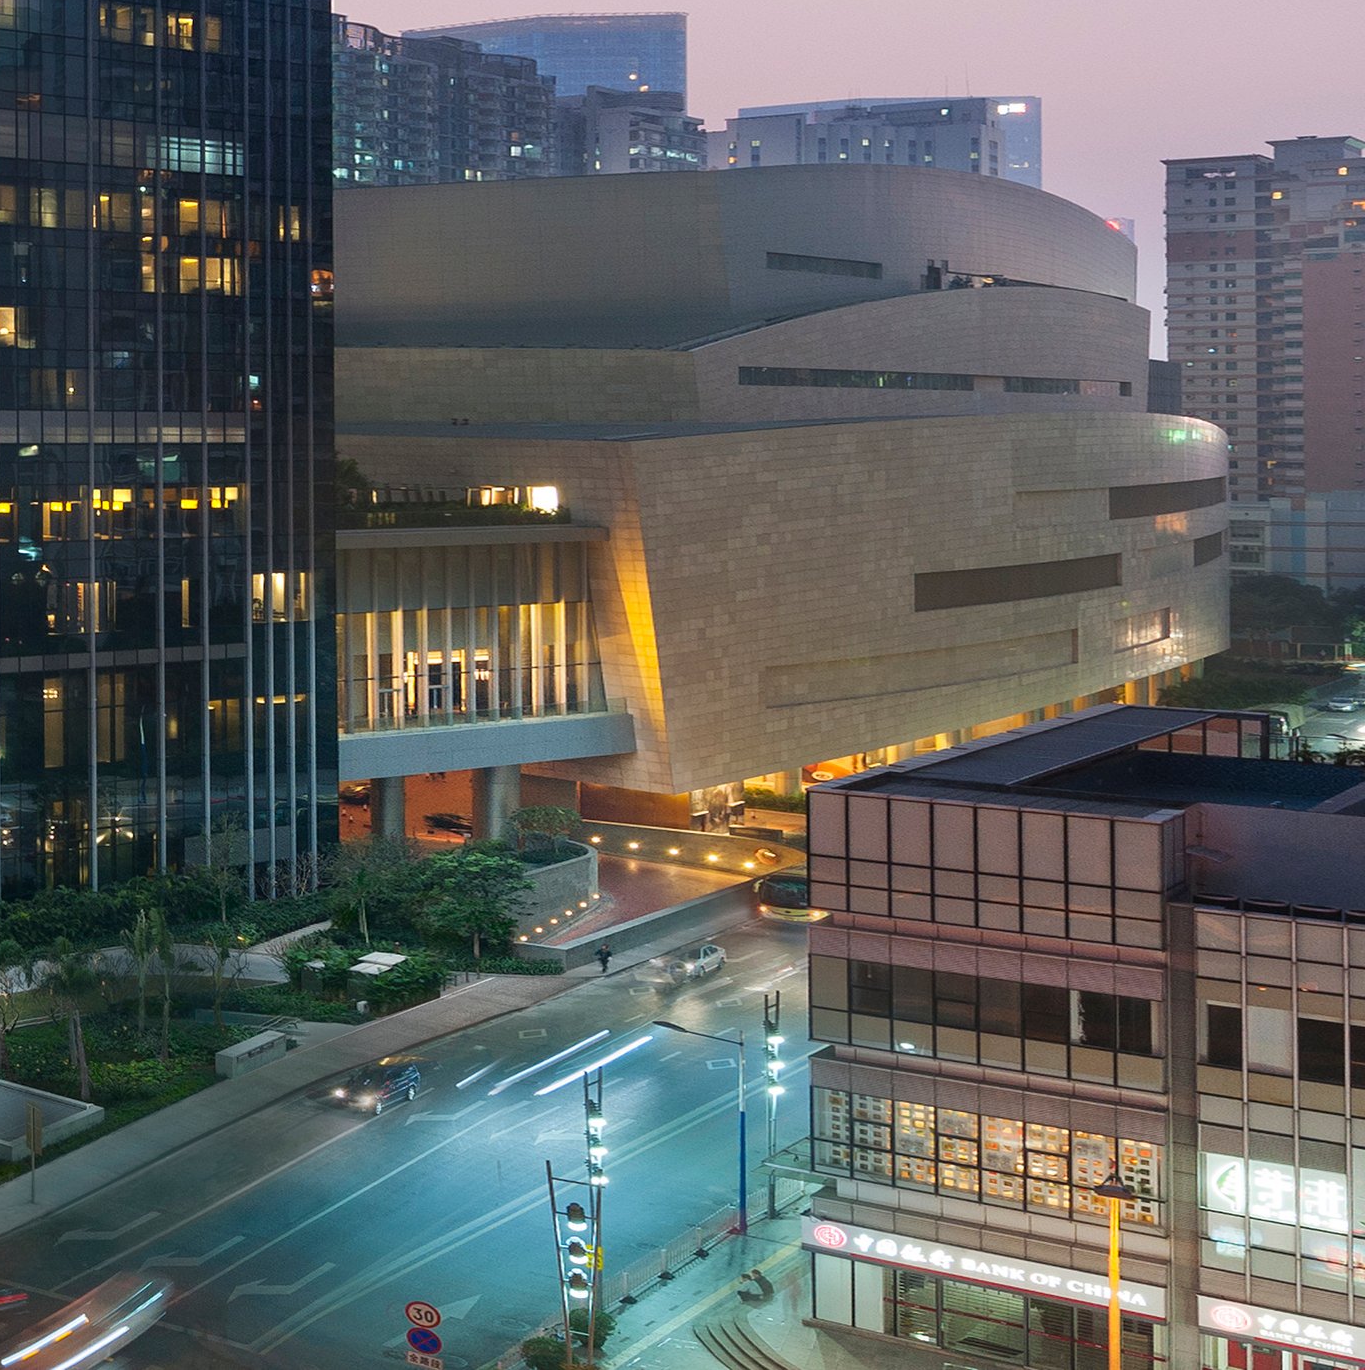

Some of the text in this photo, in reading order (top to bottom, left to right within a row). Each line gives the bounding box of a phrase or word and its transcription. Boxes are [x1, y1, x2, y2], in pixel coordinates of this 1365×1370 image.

[853, 1232, 1147, 1307] 中国银行 BANK OF CHINA
[412, 1307, 434, 1323] 30
[1257, 1314, 1355, 1347] 中国银行
[1259, 1329, 1354, 1355] BANK OF CHINA
